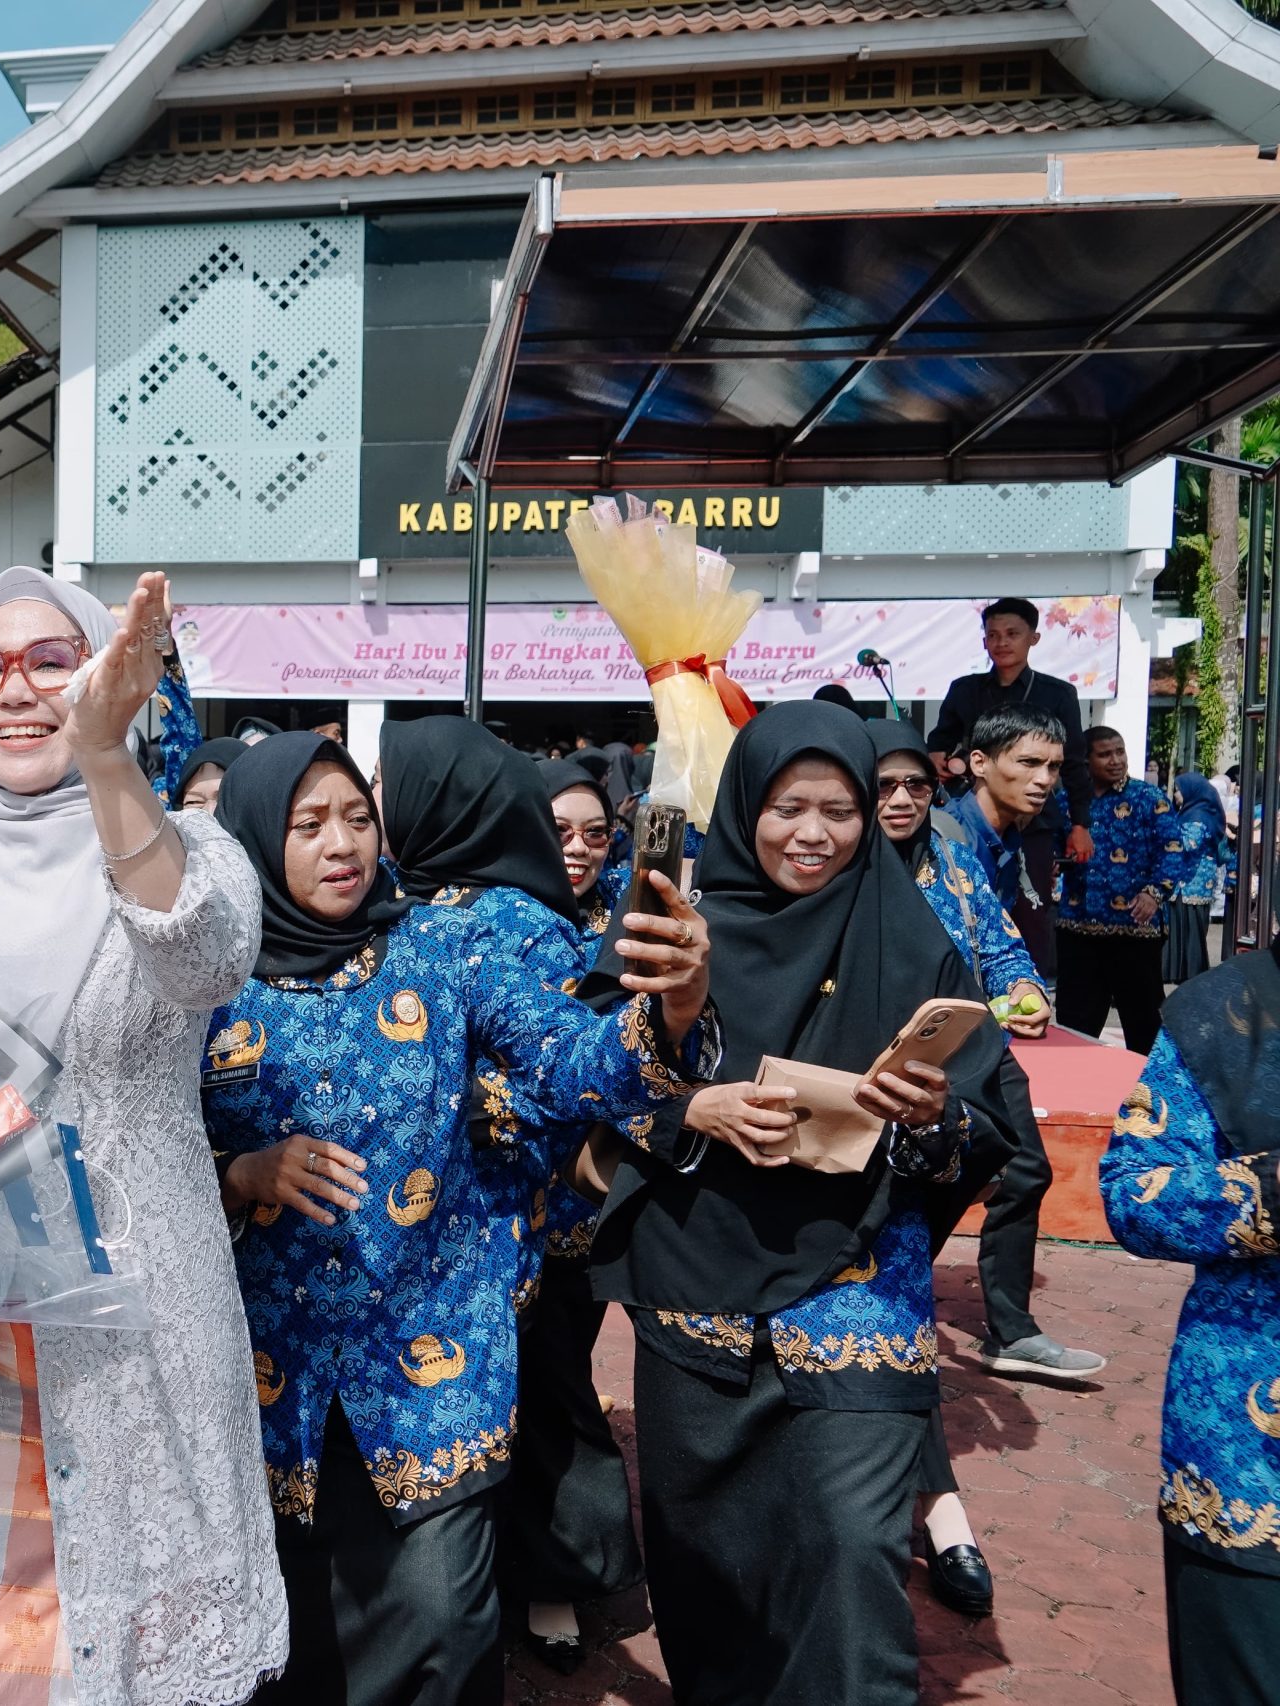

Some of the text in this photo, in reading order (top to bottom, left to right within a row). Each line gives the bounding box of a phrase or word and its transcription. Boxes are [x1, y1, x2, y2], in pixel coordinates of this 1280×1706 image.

[354, 642, 405, 660] Hari
[412, 643, 447, 660] Ibu
[525, 642, 610, 664] Tingkat
[743, 641, 816, 660] Barru
[282, 662, 379, 684] Perempuan
[384, 663, 460, 684] Berdaya
[483, 669, 499, 680] an
[729, 663, 777, 680] nesia
[782, 662, 835, 684] Emas
